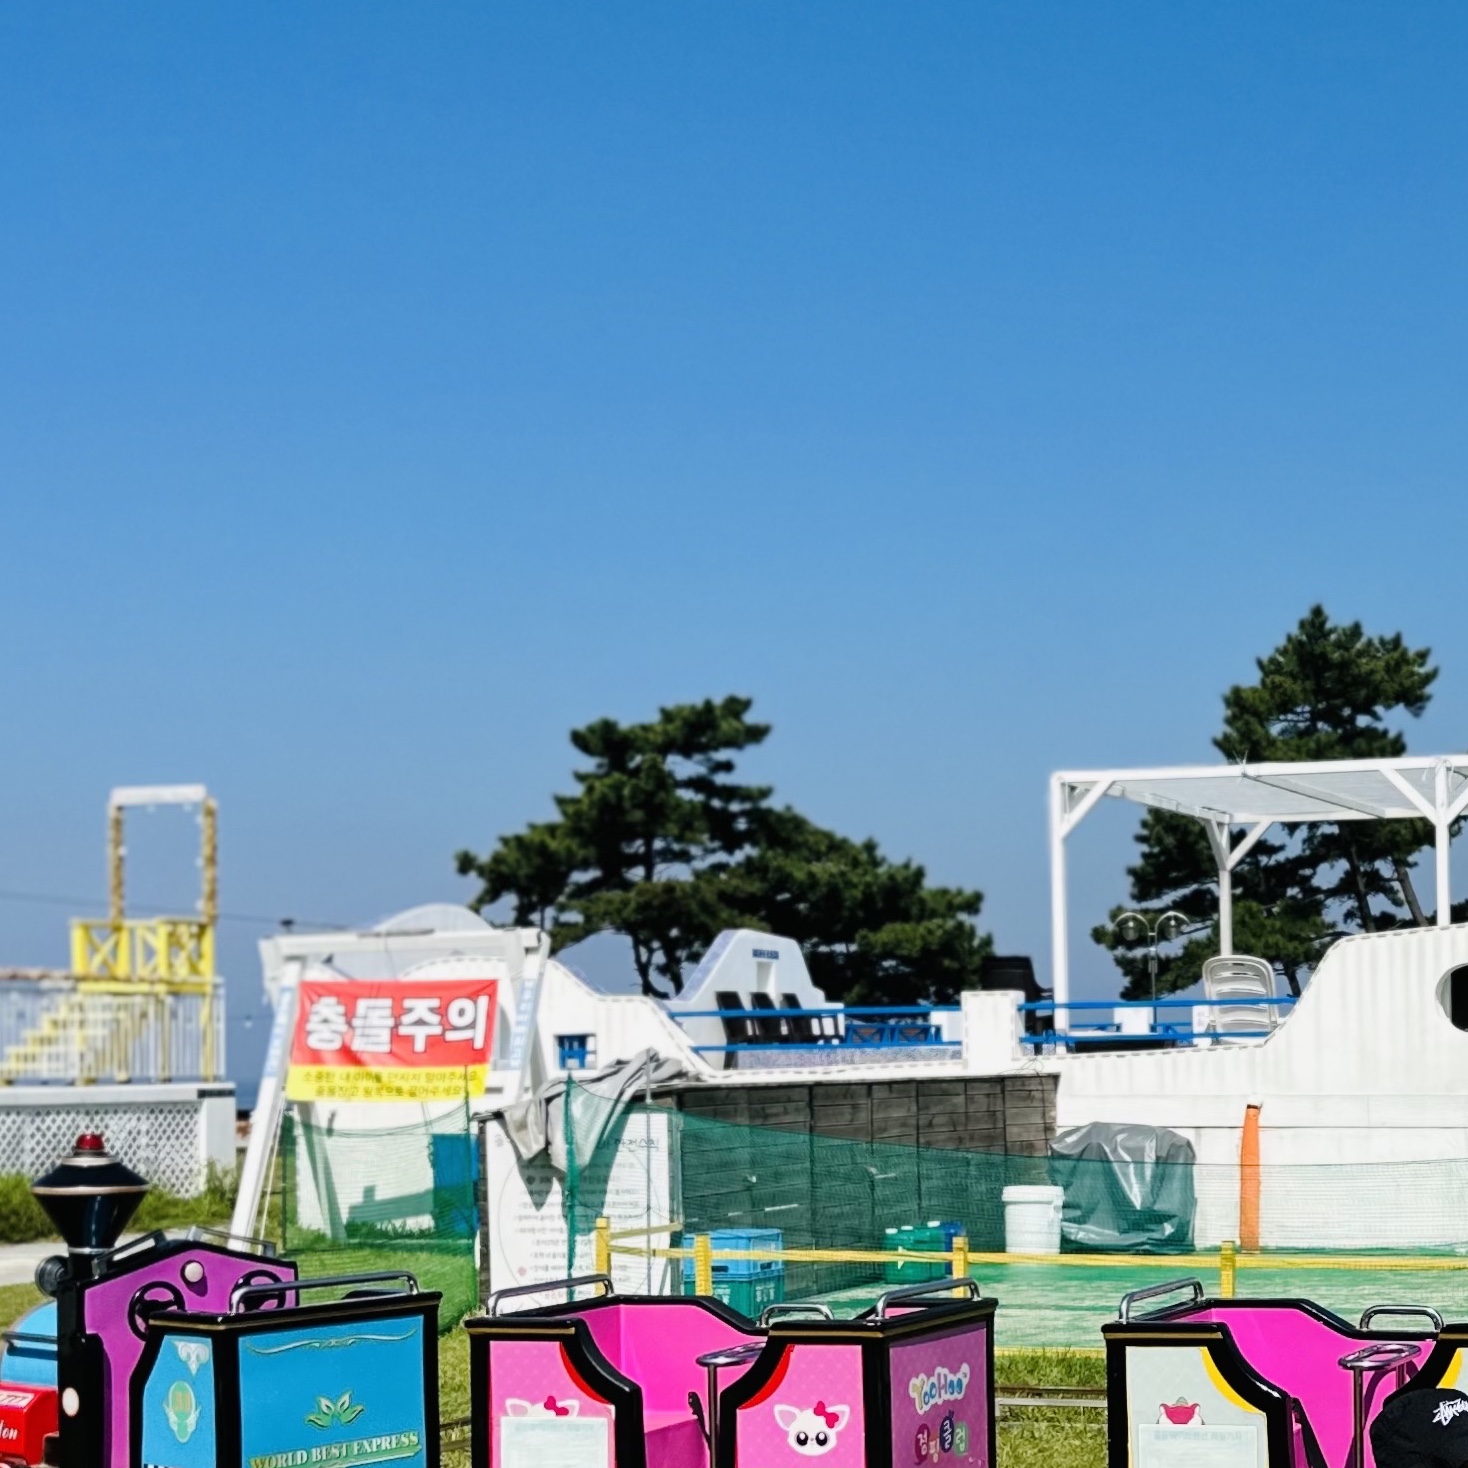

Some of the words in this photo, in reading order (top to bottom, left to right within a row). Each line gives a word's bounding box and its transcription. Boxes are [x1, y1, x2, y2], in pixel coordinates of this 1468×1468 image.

[304, 994, 491, 1054] 충돌주의
[311, 1443, 348, 1463] BEST
[353, 1431, 420, 1456] EXPRESS
